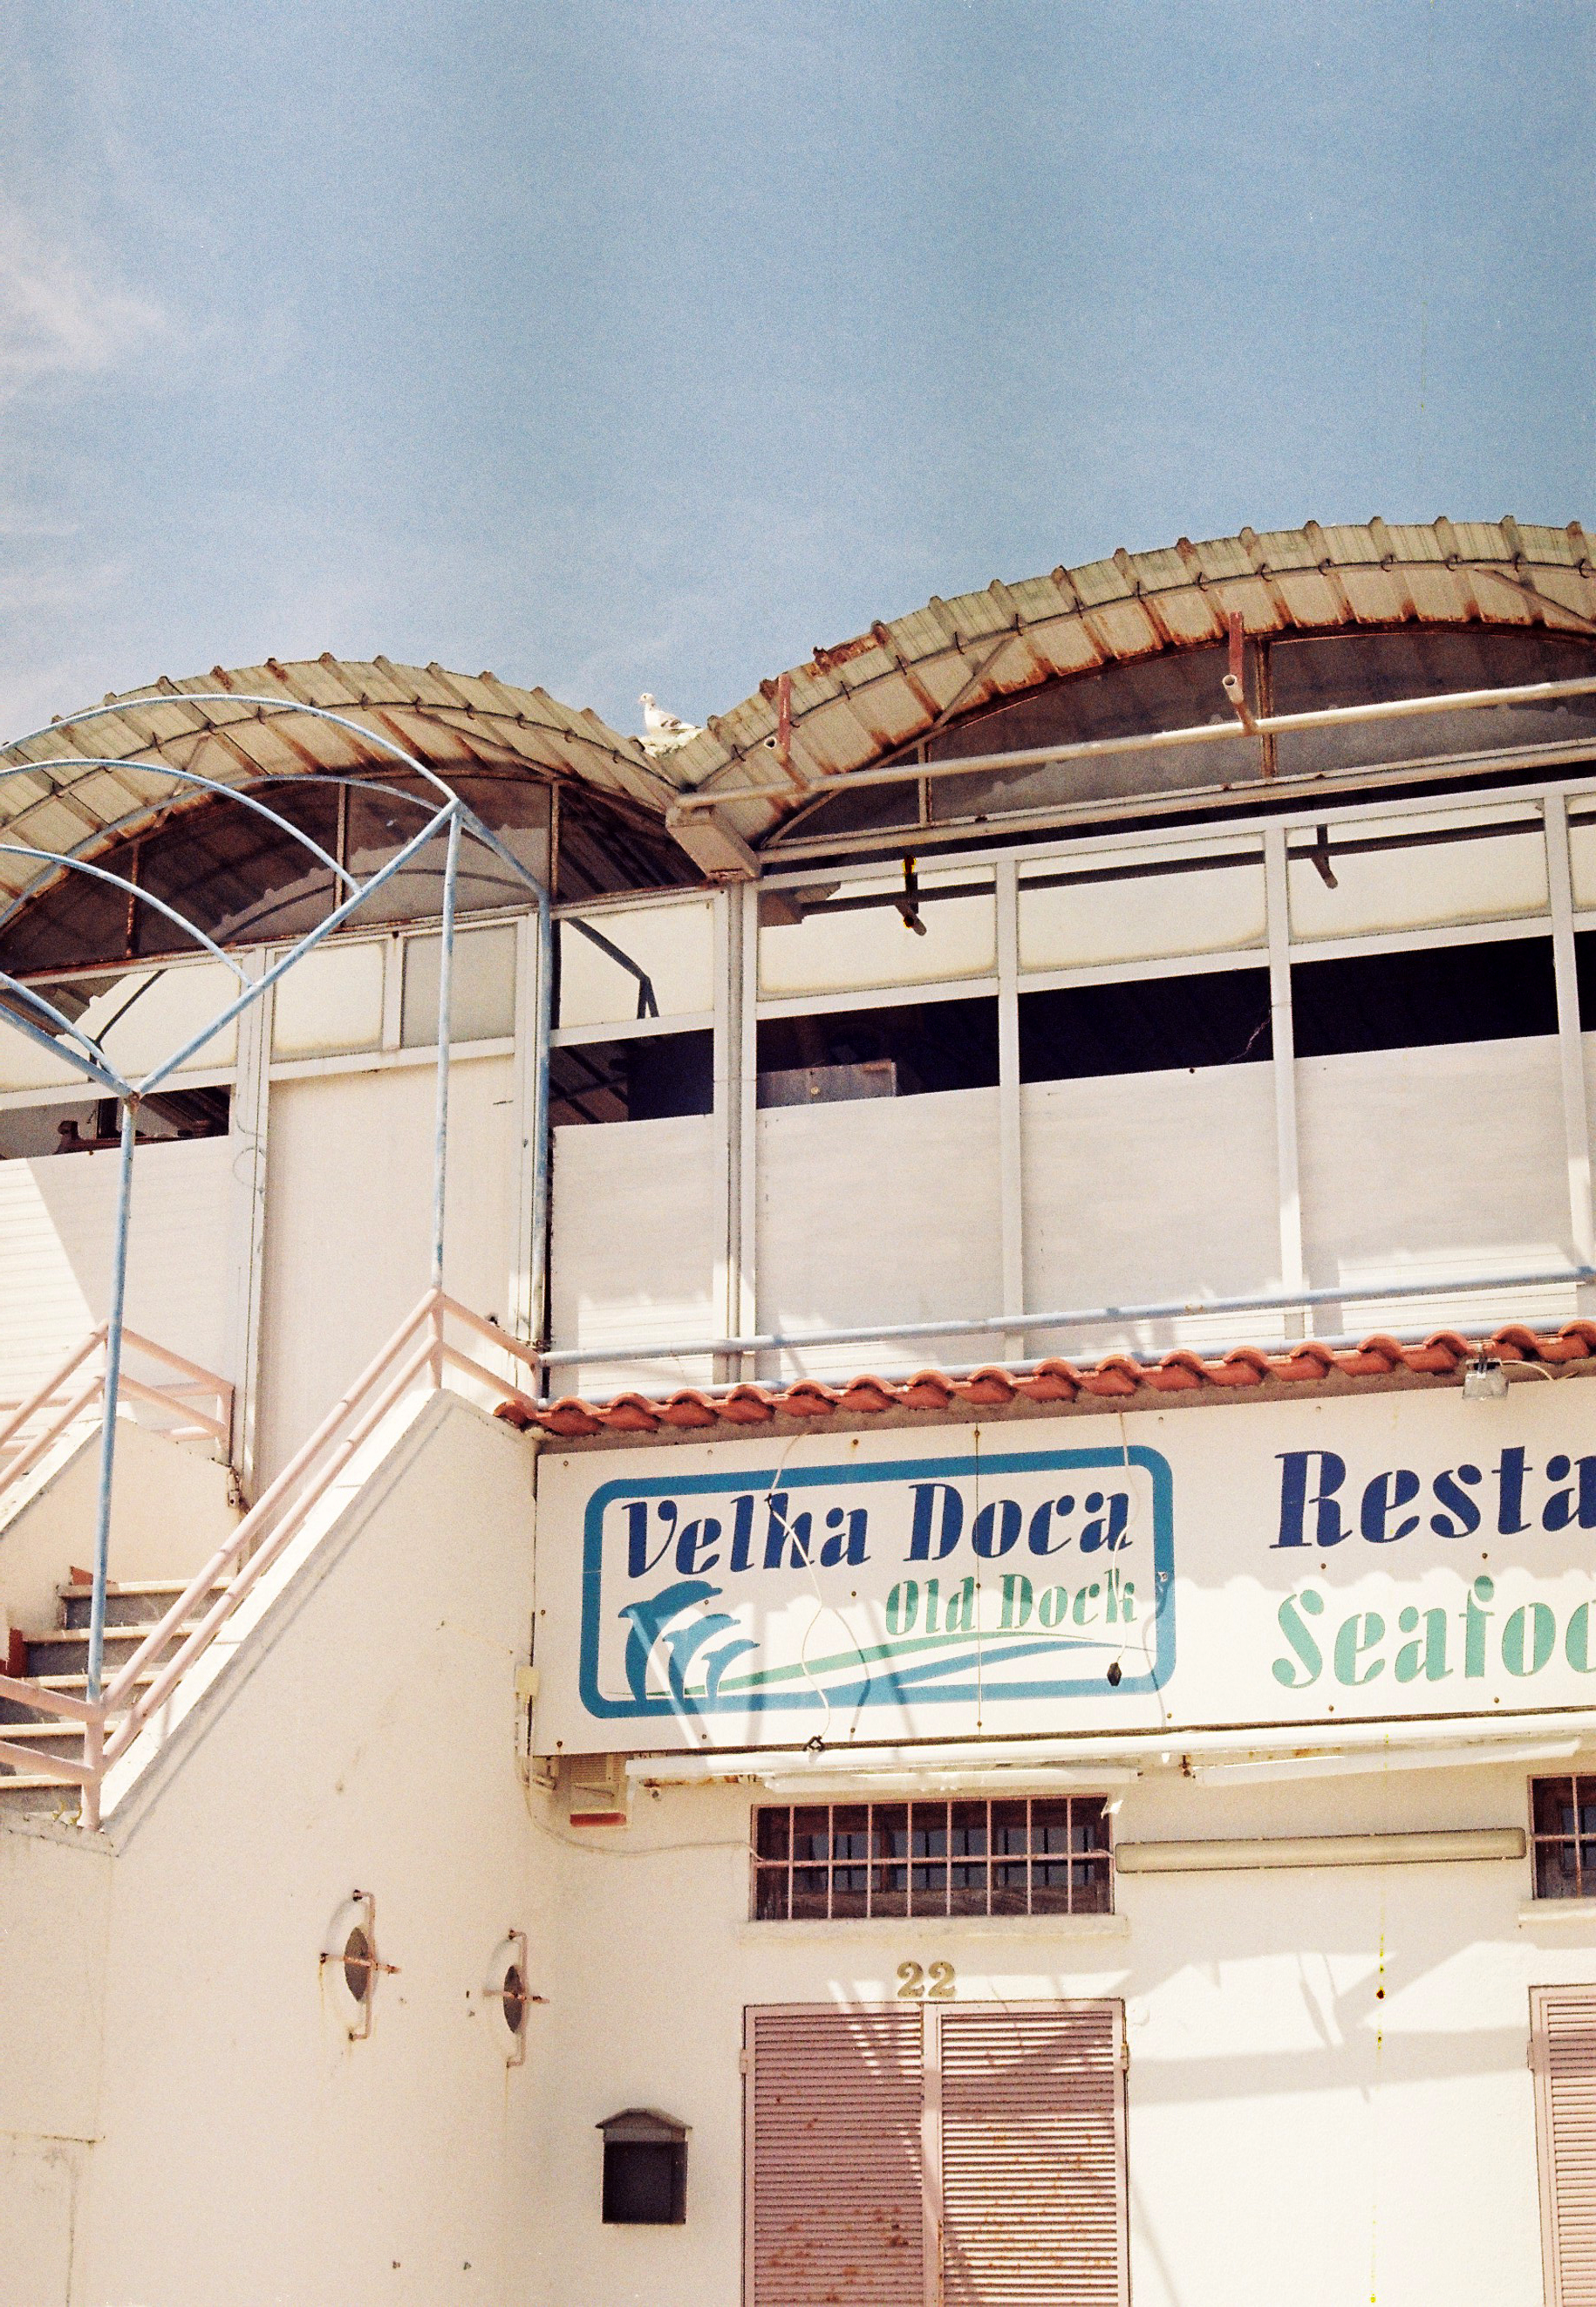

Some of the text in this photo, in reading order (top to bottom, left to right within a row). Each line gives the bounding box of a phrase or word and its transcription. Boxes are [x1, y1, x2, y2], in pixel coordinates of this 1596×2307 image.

[621, 1483, 1132, 1579] Velha Doca
[1269, 1446, 1596, 1548] Resta
[885, 1568, 1137, 1636] Old Dock
[897, 1961, 956, 1997] 22
